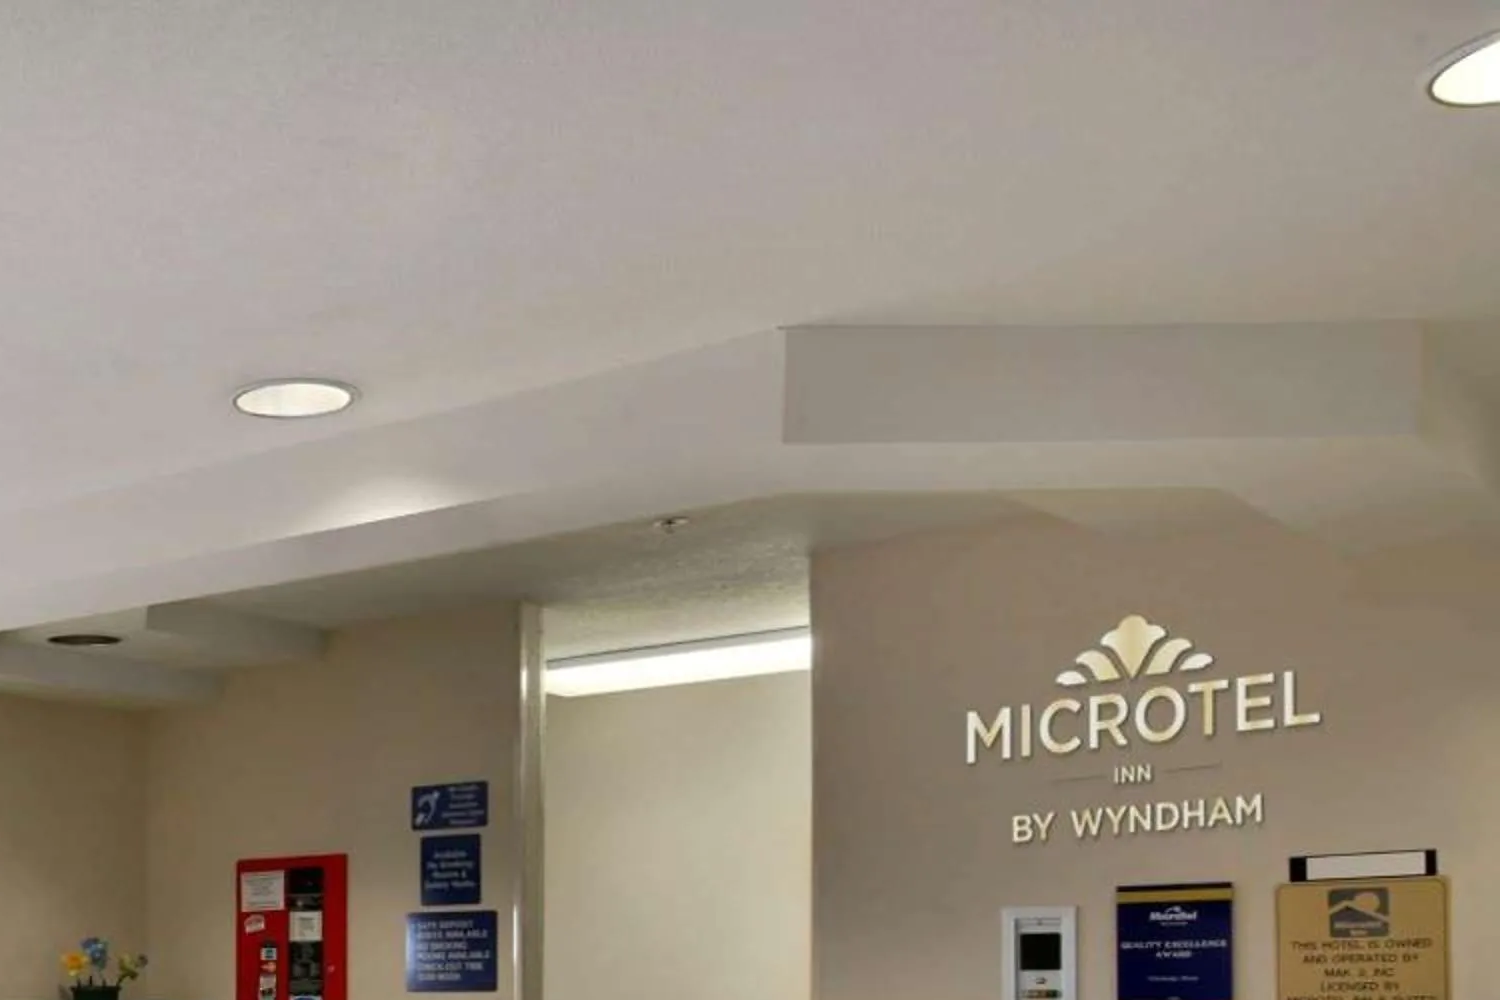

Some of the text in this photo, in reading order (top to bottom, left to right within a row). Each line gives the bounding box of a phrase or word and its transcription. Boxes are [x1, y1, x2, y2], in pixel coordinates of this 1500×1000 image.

[965, 670, 1322, 765] MICROTEL
[1113, 764, 1153, 785] INN
[1011, 793, 1265, 844] BY WYNDHAM
[1322, 939, 1364, 950] HOTEL
[1384, 937, 1433, 949] OWNED
[1332, 954, 1398, 964] OPERATED
